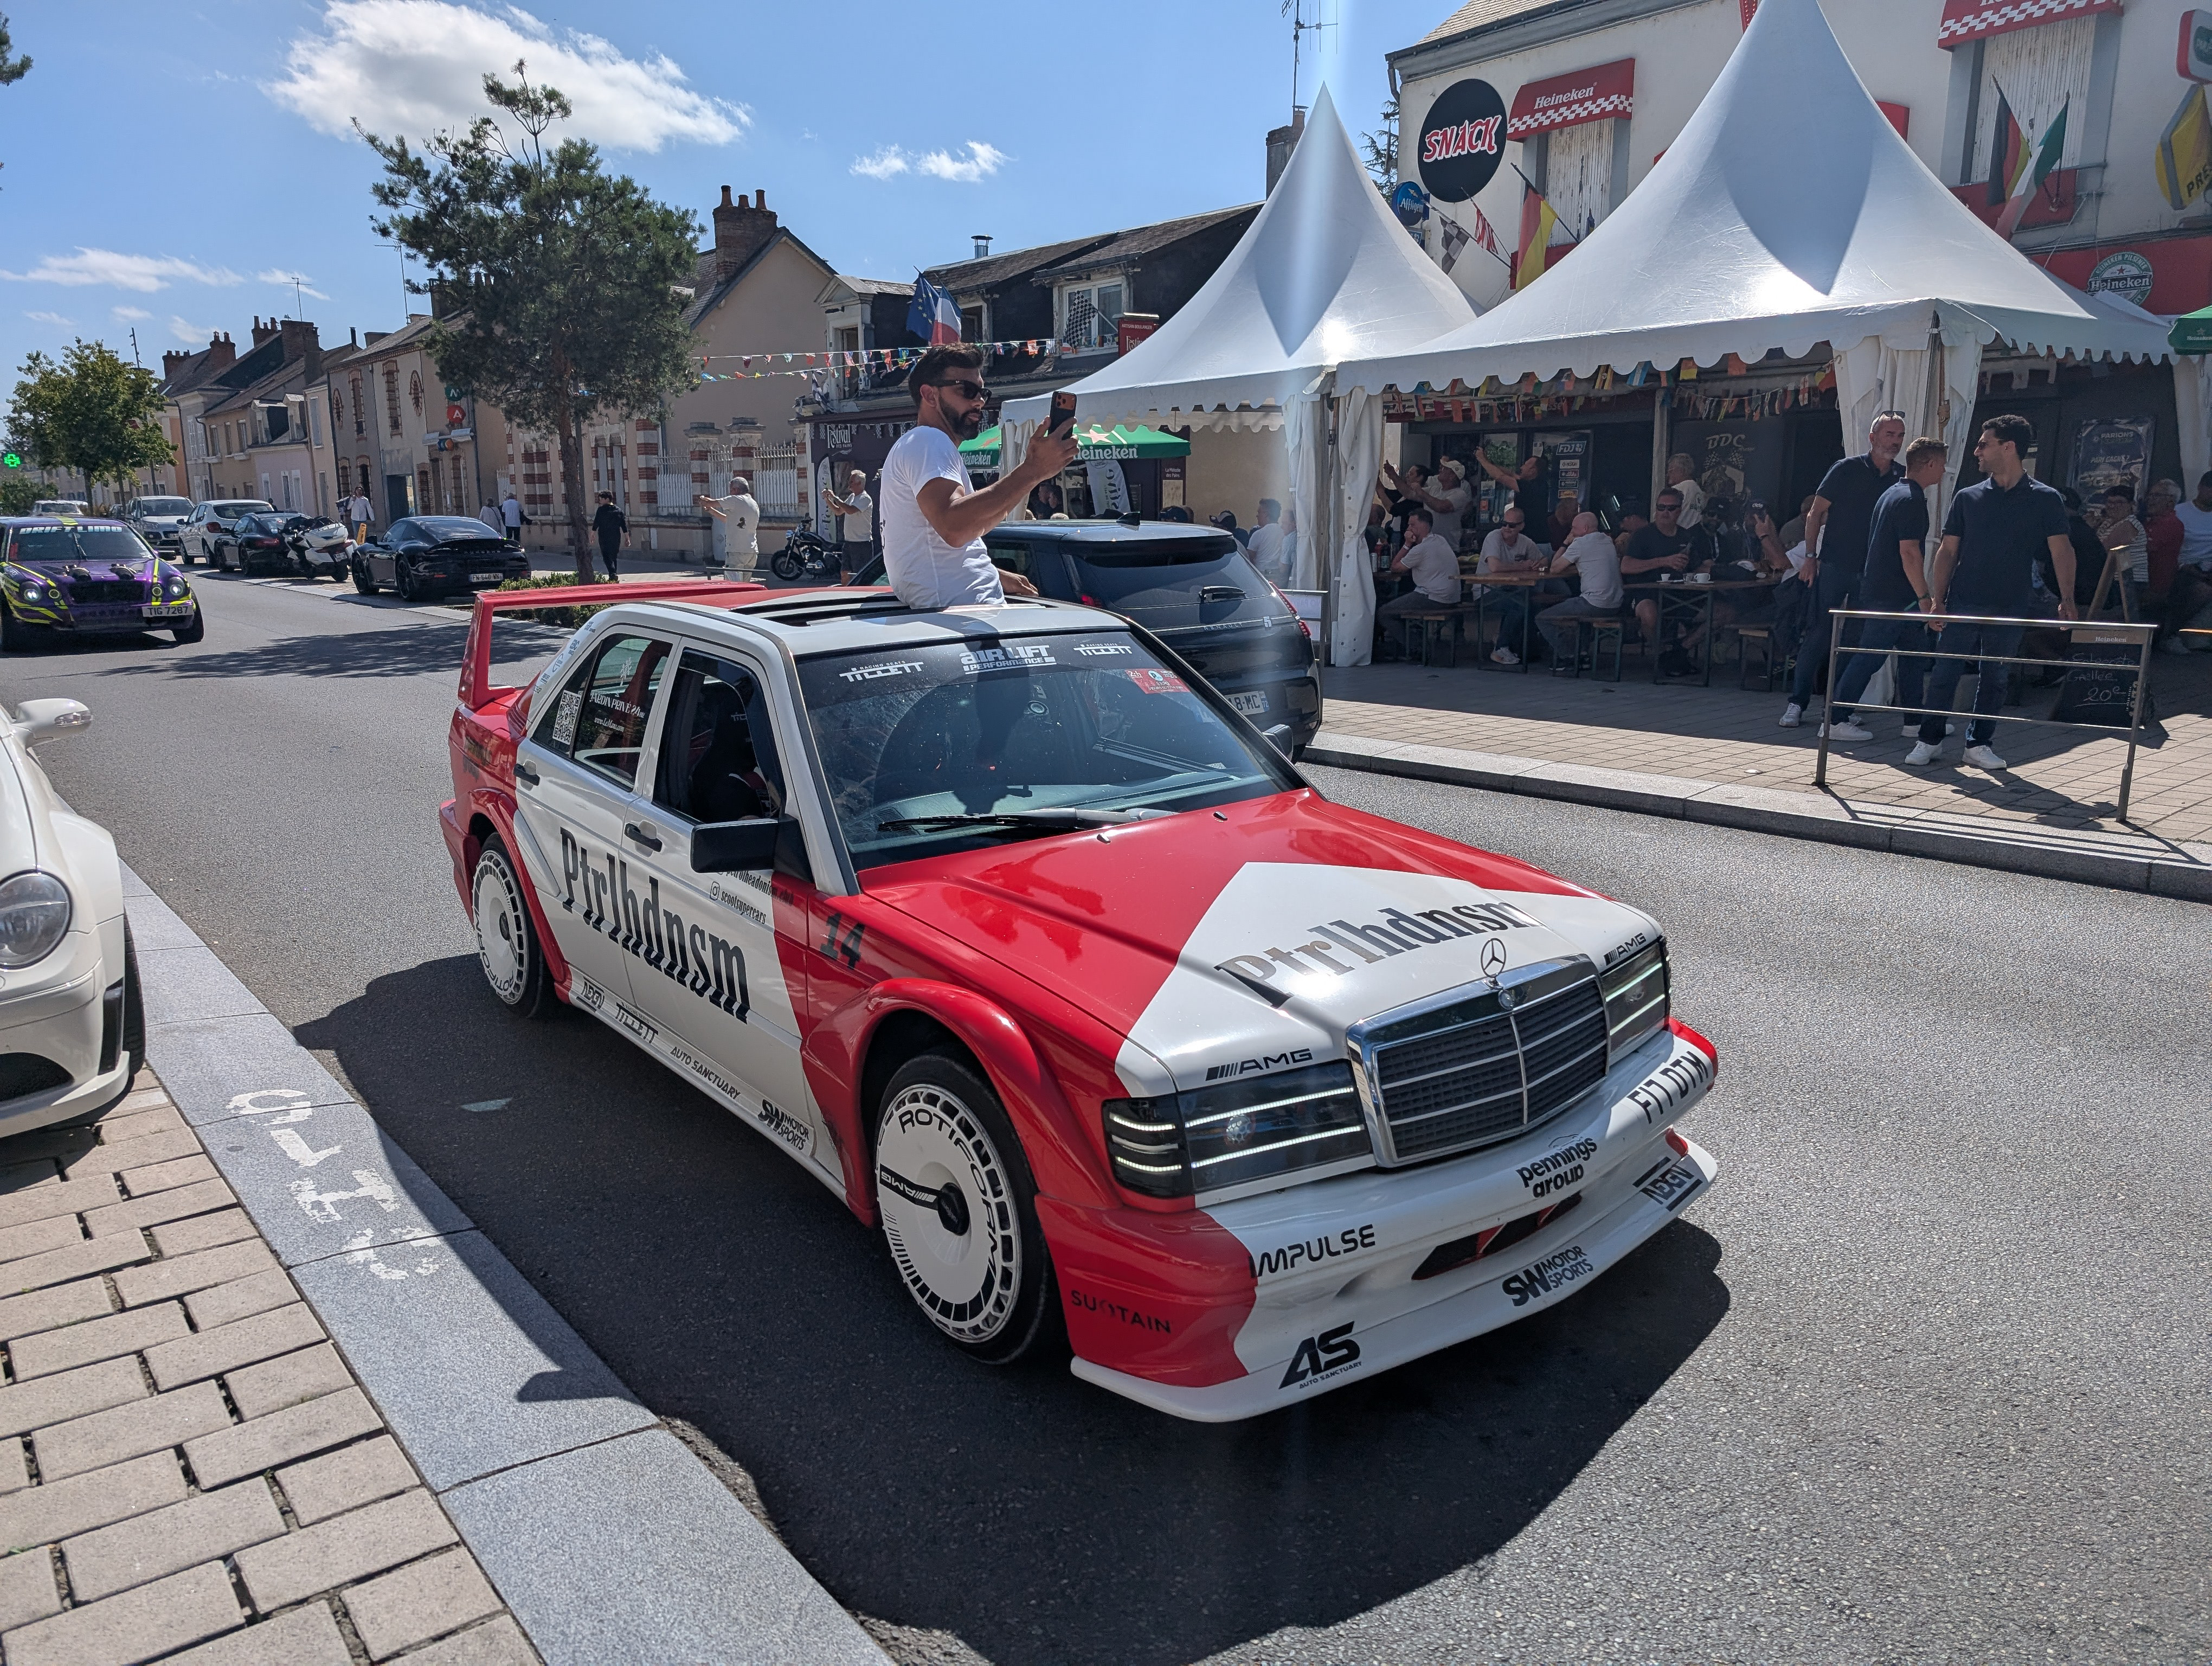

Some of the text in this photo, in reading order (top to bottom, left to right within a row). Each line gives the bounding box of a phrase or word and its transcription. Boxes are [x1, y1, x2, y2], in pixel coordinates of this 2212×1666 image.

[1534, 86, 1594, 110] Heineken
[1423, 114, 1502, 162] SNACK
[2125, 254, 2147, 270] PILSENER
[2091, 277, 2150, 290] Heineken
[453, 409, 462, 419] A
[827, 424, 851, 448] Festival
[1559, 444, 1575, 453] FDJ
[1706, 434, 1745, 449] BDC
[962, 451, 992, 465] Heineken
[19, 526, 75, 535] DRIFT
[165, 606, 188, 614] 7287
[1204, 623, 1243, 631] RENAULT
[1006, 645, 1050, 659] LIFT
[1073, 646, 1133, 656] TILLETT
[839, 662, 924, 682] TILLETT
[721, 890, 767, 925] scootsupercars
[560, 827, 750, 1024] Ptrlhdnsm
[820, 913, 866, 971] 14
[1214, 900, 1544, 1008] Ptrlhdnsm
[1616, 932, 1647, 958] AMG
[615, 1002, 659, 1043] TILLETT
[670, 1046, 741, 1100] AUTO SANCTUARY
[1239, 1048, 1313, 1074] AMG
[1663, 1050, 1710, 1099] DTM
[758, 1099, 810, 1140] SW MOTOR
[779, 1124, 807, 1151] SPORTS
[1516, 1136, 1597, 1188] pennings
[898, 1107, 998, 1274] ROTIFORM
[1532, 1163, 1585, 1199] group
[1250, 1223, 1376, 1278] IMPULSE
[1544, 1246, 1587, 1273] MOTOR
[1502, 1259, 1594, 1306] SW SPORTS
[1278, 1321, 1361, 1389] AS
[1299, 1360, 1362, 1389] AUTO SANCTUARY
